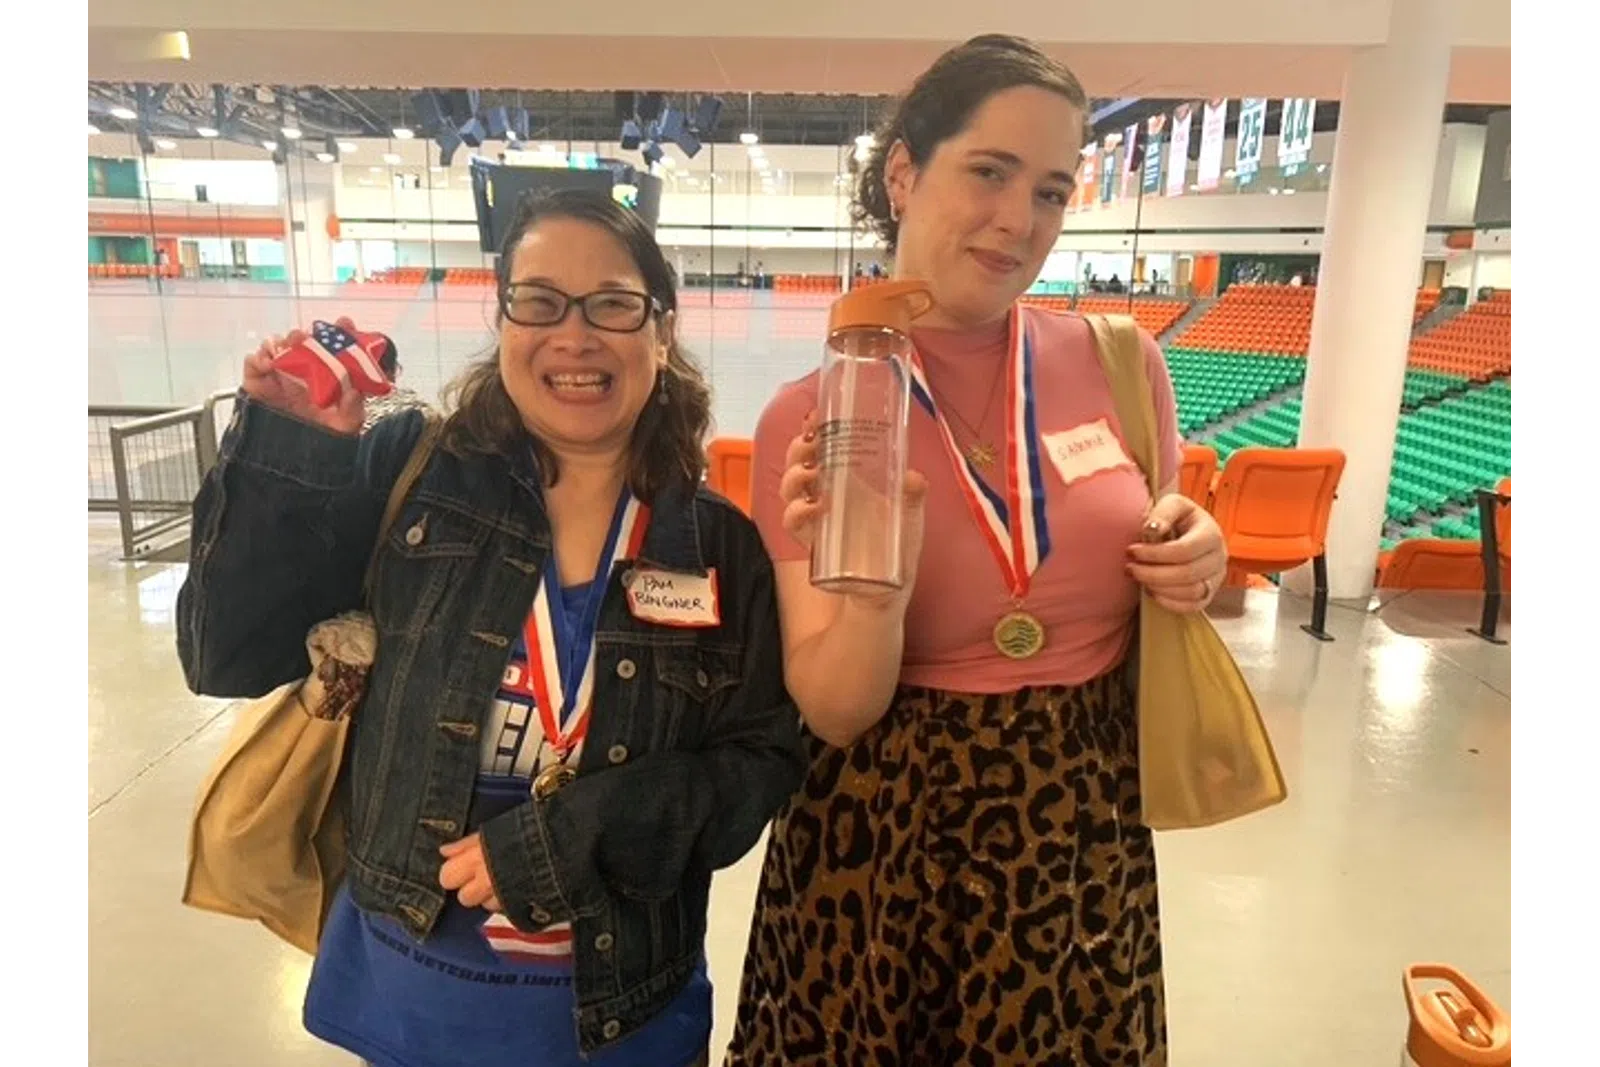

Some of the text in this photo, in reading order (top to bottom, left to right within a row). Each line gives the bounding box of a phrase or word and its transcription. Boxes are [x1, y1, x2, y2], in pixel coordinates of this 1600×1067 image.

[1239, 109, 1262, 160] 25
[1283, 100, 1310, 149] 44
[642, 574, 674, 592] PAM
[634, 591, 705, 610] BINGNER
